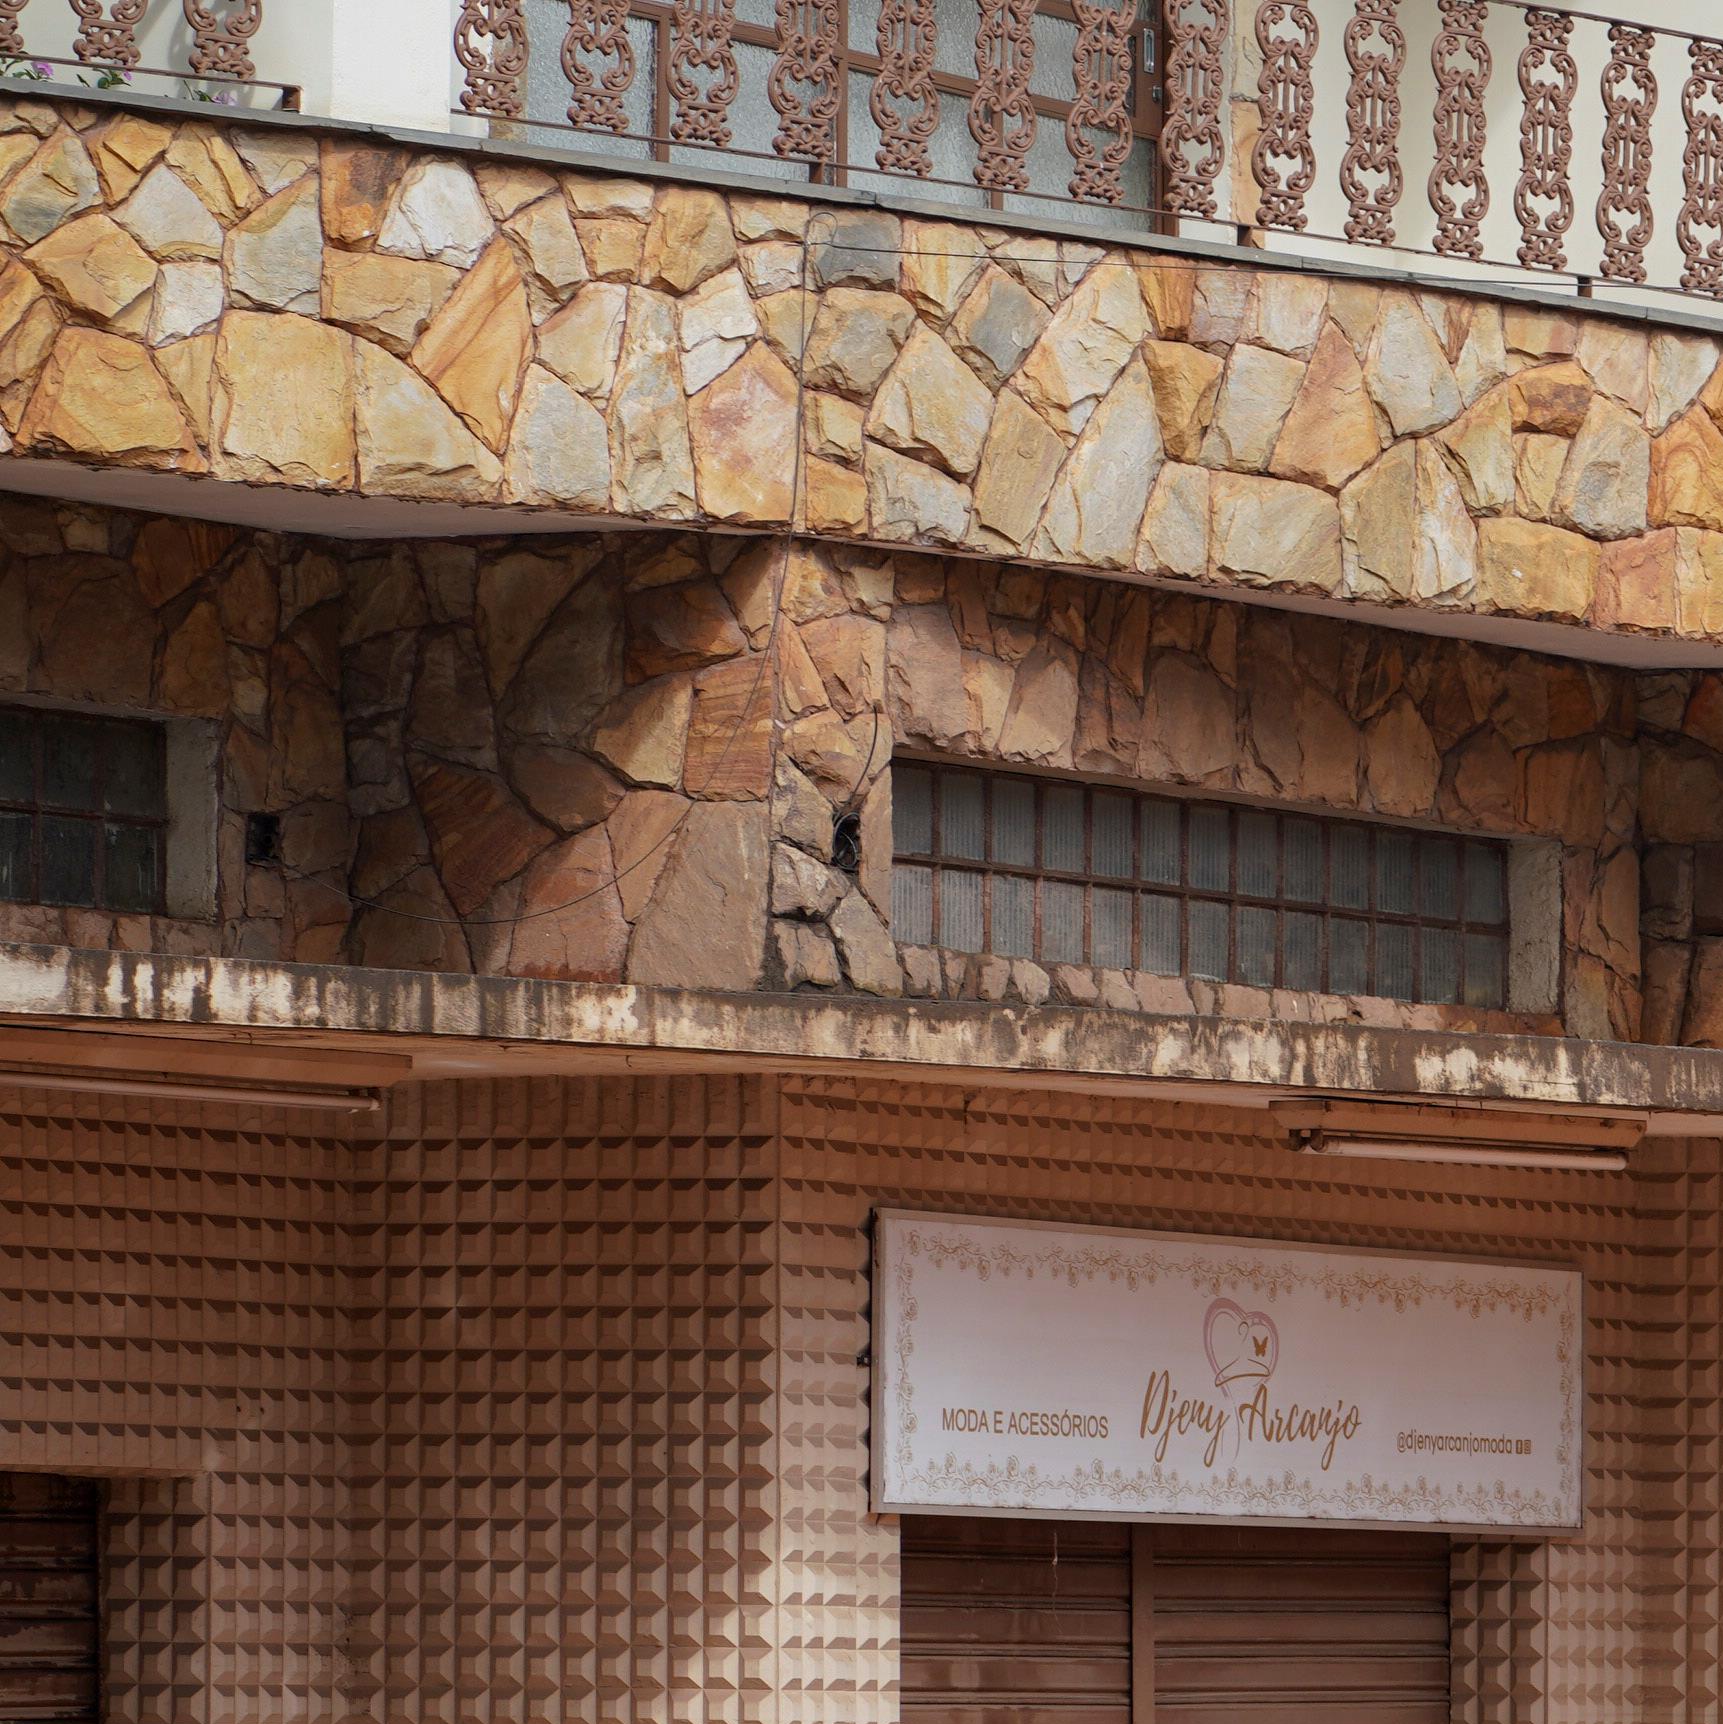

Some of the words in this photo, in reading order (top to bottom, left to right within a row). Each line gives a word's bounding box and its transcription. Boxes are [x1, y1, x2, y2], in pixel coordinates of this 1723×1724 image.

[941, 1407, 989, 1433] MODA
[993, 1410, 1003, 1434] E
[1007, 1409, 1109, 1439] ACESSÓRIOS
[1139, 1369, 1231, 1468] Djeny
[1238, 1383, 1362, 1471] Arcanjo
[1396, 1430, 1513, 1457] @djenyarcanjomoda
